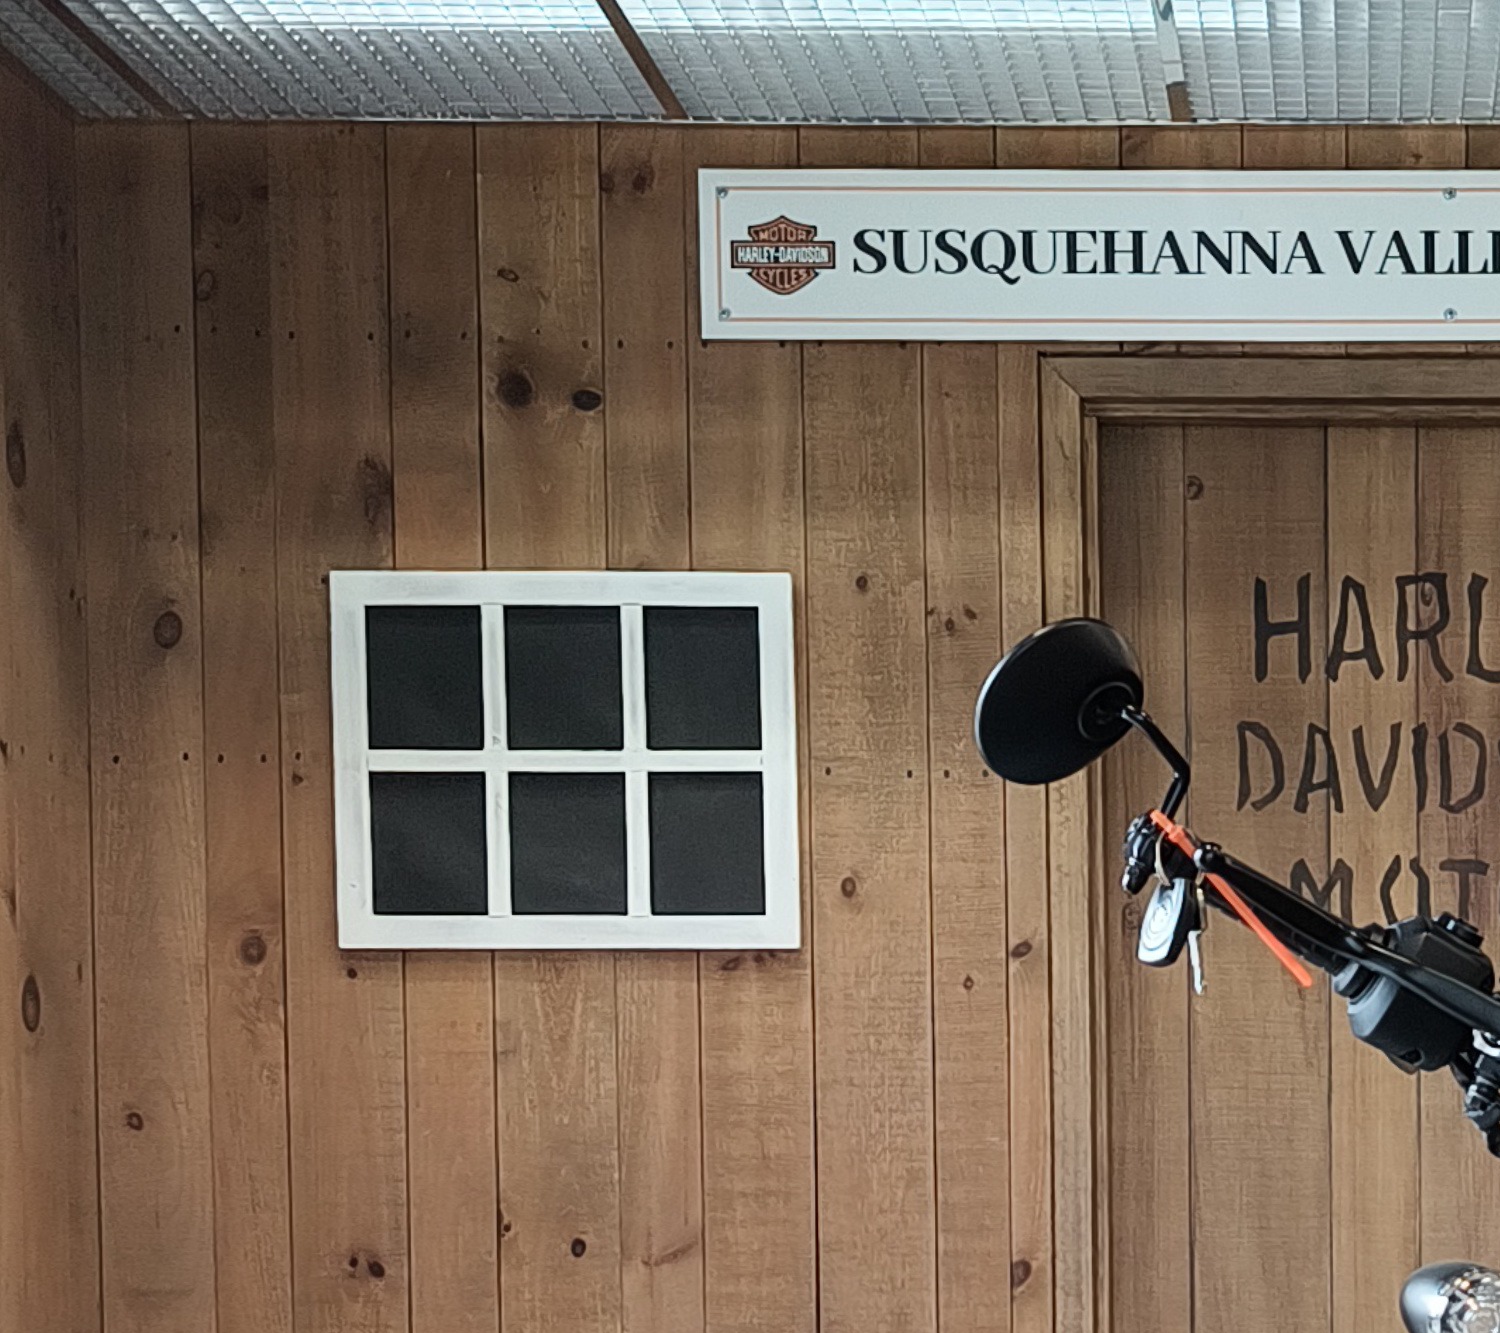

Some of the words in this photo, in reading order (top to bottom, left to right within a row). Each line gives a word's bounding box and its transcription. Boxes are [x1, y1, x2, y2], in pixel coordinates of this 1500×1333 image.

[758, 224, 807, 242] MOTOR
[737, 246, 829, 263] HARLEY-DAVIDSON
[852, 228, 1325, 285] SUSQUEHANNA
[759, 268, 808, 289] CYCLES
